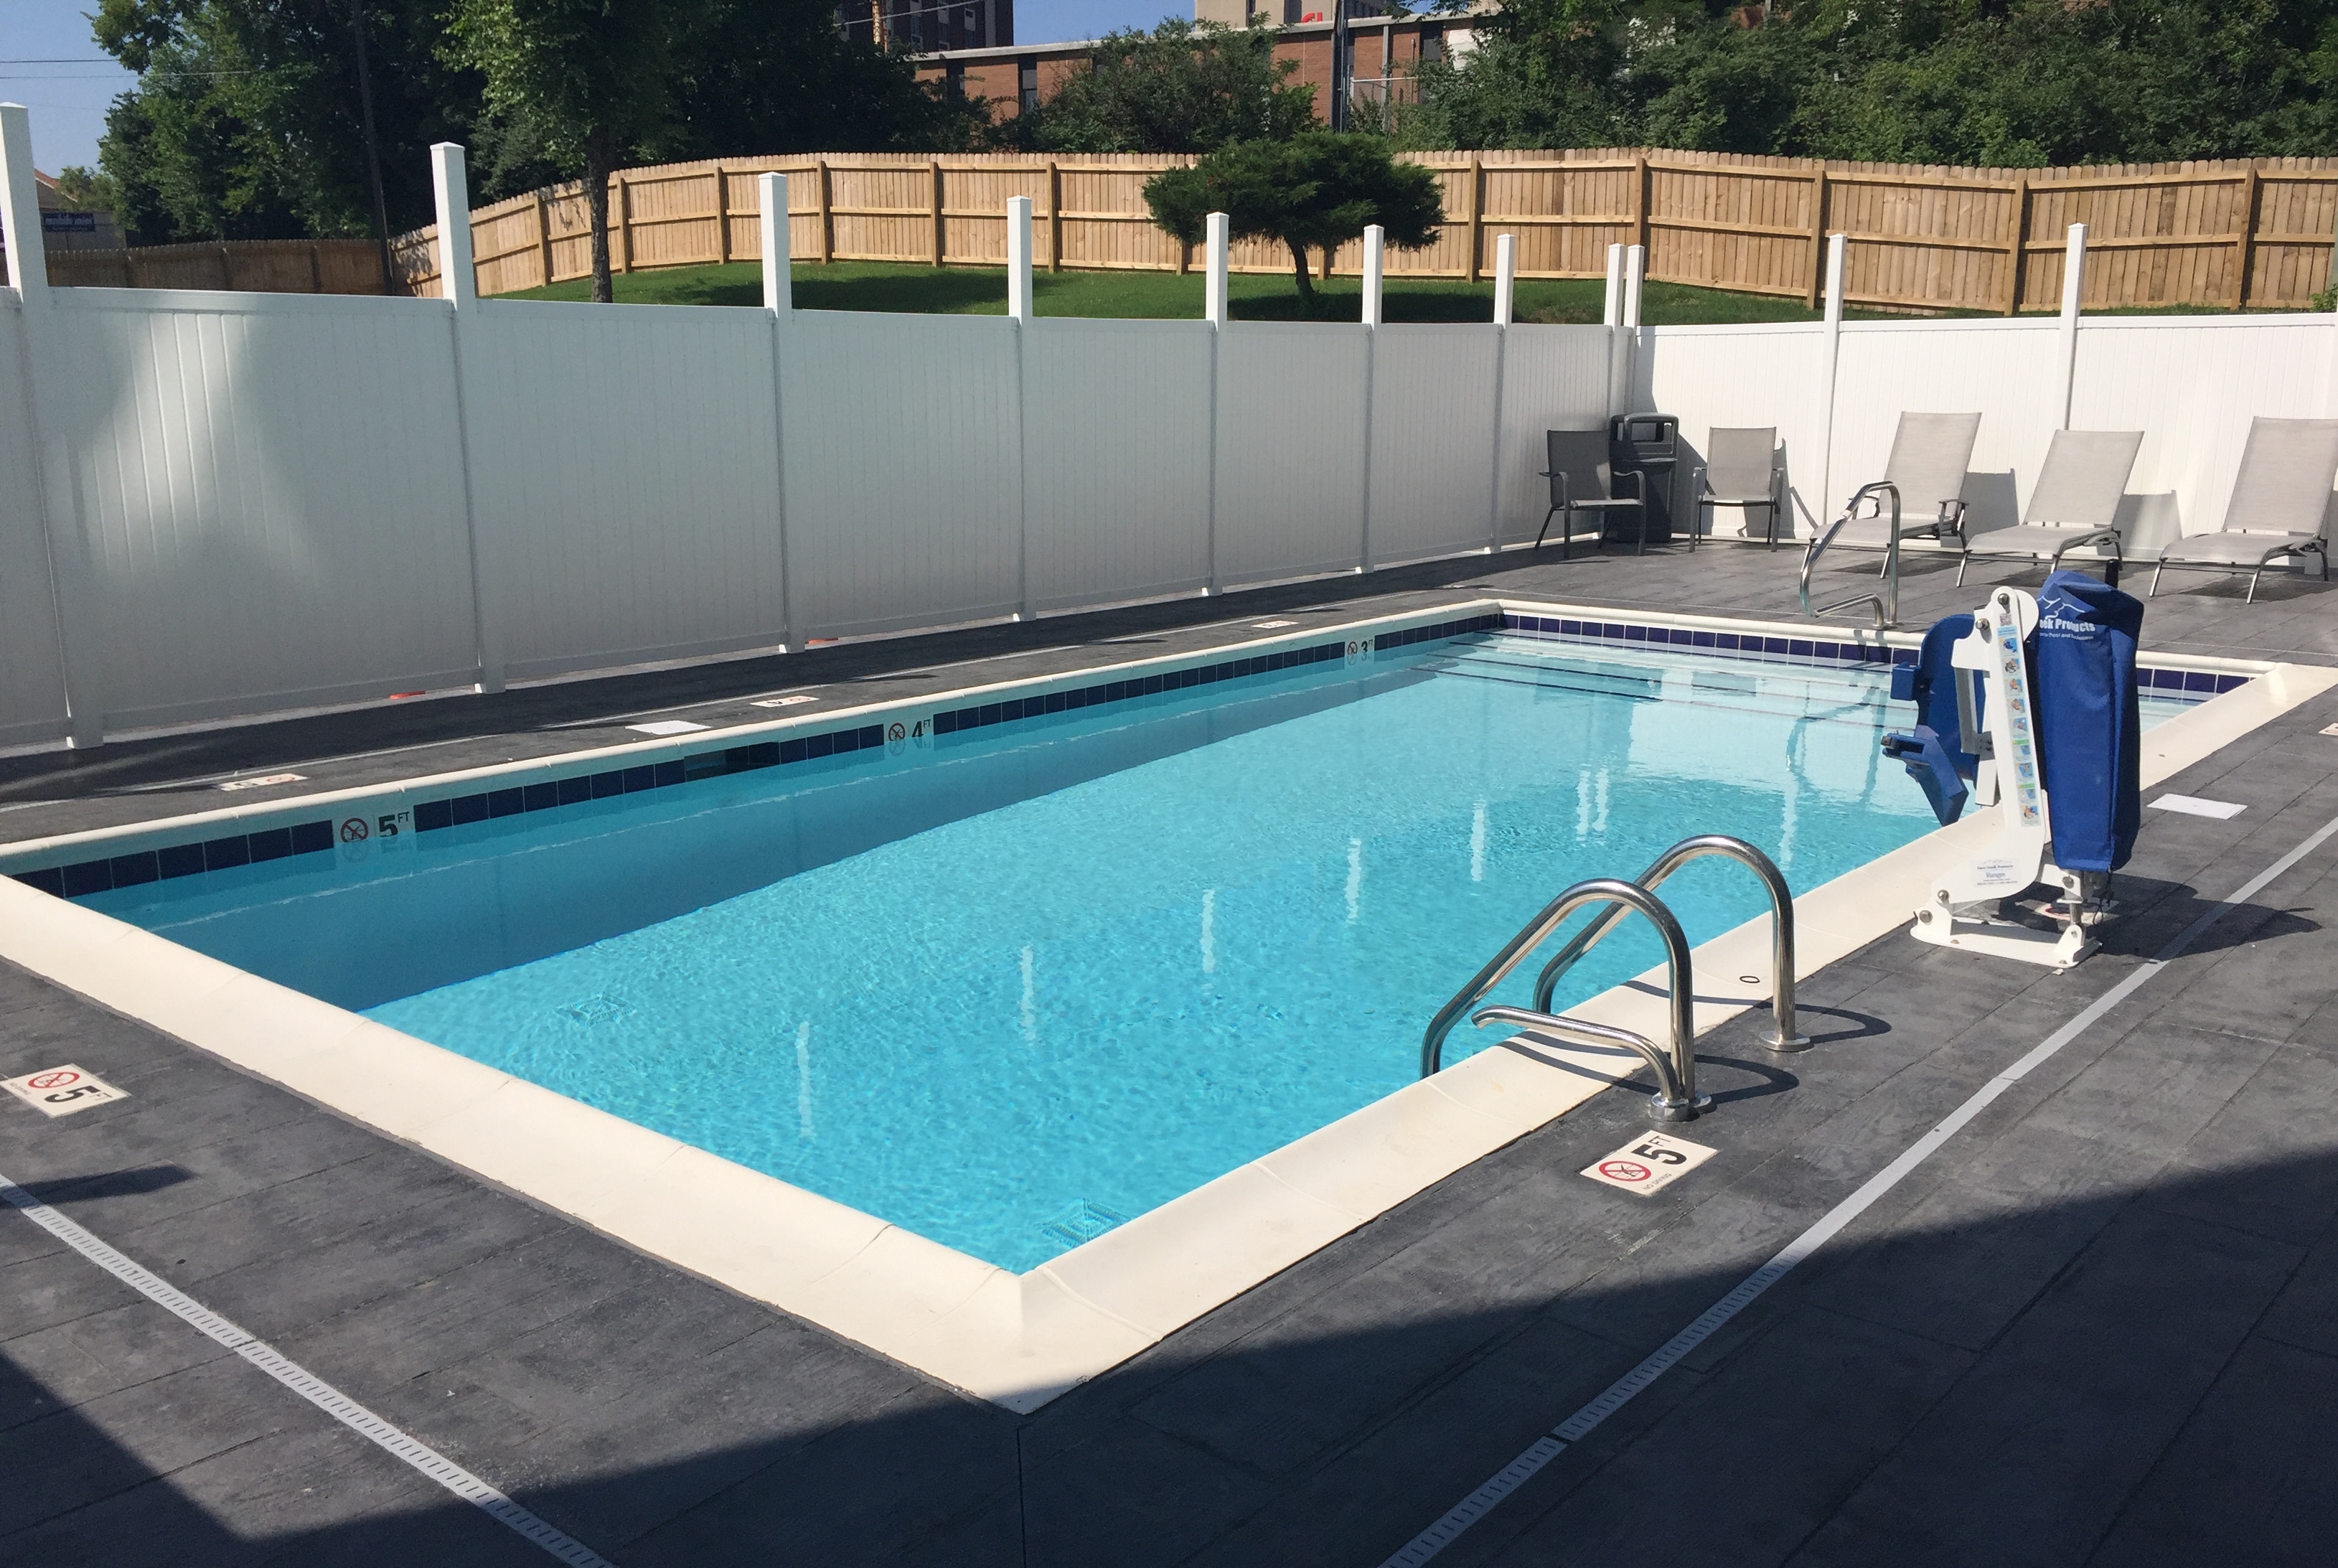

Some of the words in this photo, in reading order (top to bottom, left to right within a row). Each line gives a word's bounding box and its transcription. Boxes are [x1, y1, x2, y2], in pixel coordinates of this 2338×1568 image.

[1361, 640, 1368, 653] 3
[911, 720, 924, 738] 4
[923, 719, 931, 728] FT
[378, 814, 398, 838] 5
[398, 811, 410, 823] FT
[44, 1085, 101, 1103] 5
[88, 1092, 113, 1102] FT
[1648, 1135, 1671, 1147] FT
[1630, 1143, 1687, 1166] 5
[1651, 1173, 1672, 1185] DIVING
